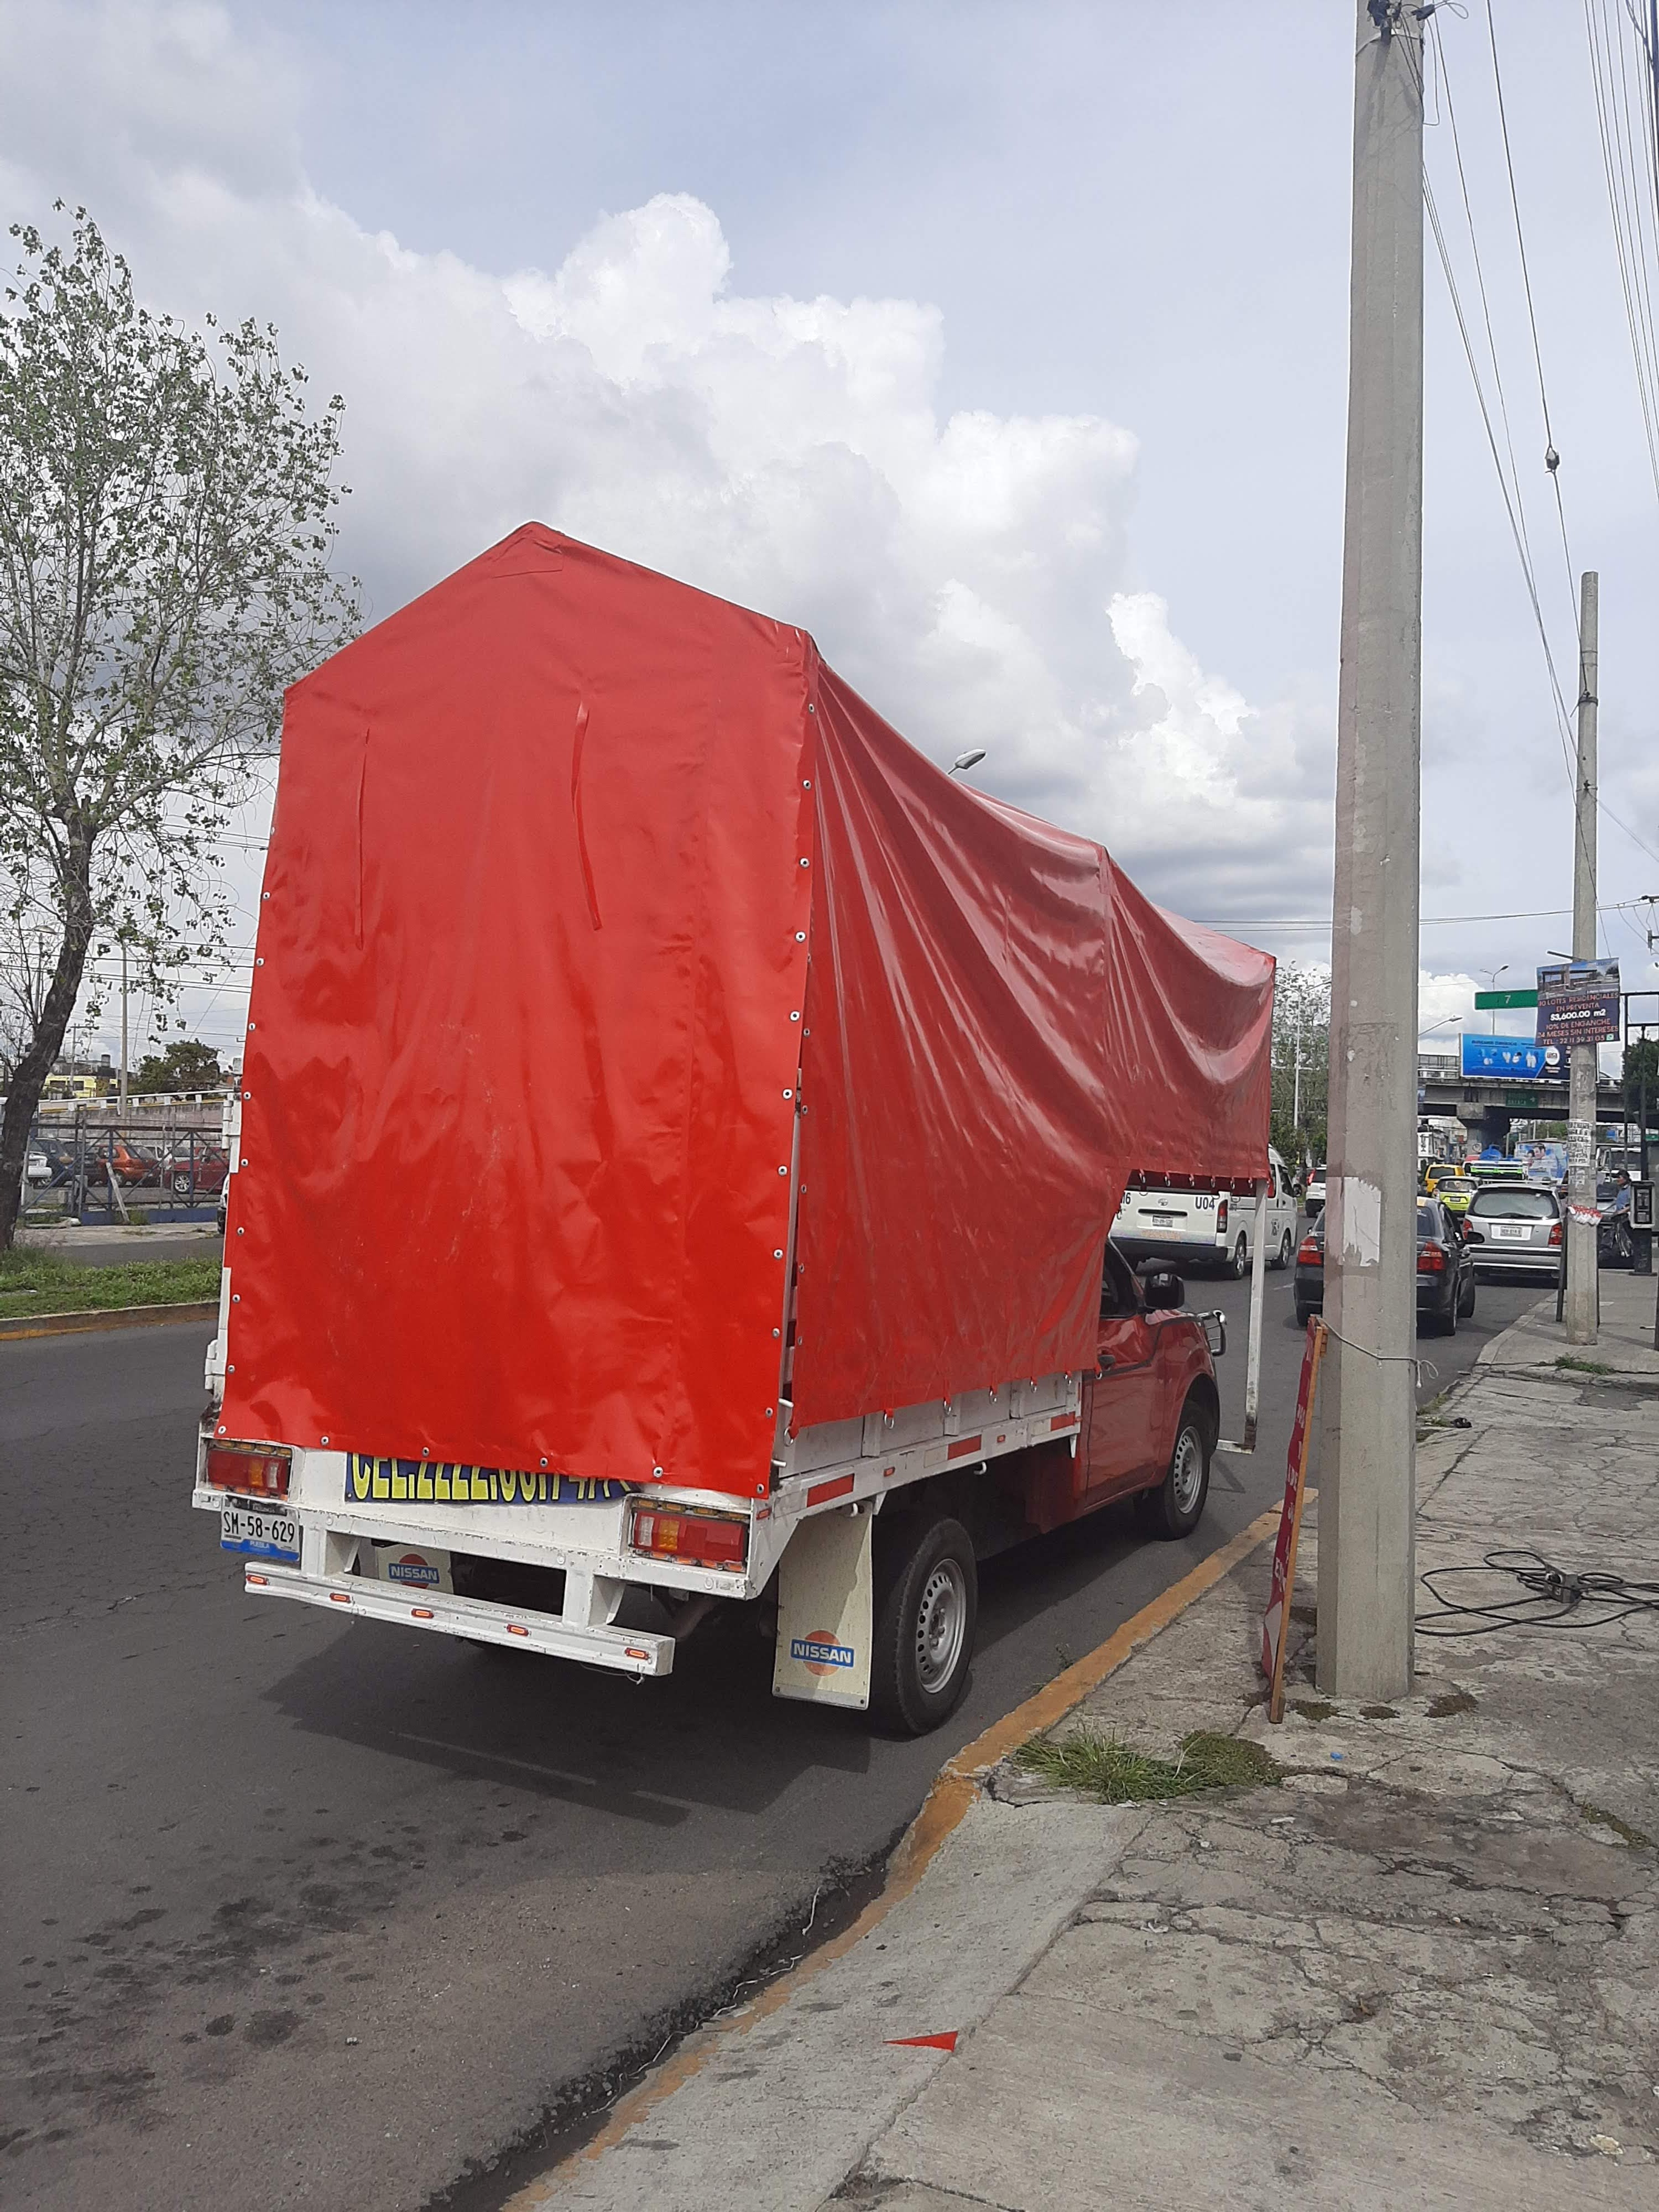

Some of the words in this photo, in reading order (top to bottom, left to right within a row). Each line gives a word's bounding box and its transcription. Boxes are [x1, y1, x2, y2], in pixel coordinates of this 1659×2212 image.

[1504, 995, 1511, 1004] 7
[1569, 993, 1619, 1003] RESIDENCIALES
[1566, 1003, 1600, 1011] PREVENTA
[1594, 1008, 1606, 1016] m2
[1571, 1018, 1611, 1028] ENGANCHE
[1583, 1025, 1619, 1034] INTERESES
[1196, 1197, 1215, 1210] U04
[223, 1511, 295, 1543] SM-58-629
[390, 1566, 437, 1580] NISSAN
[793, 1642, 851, 1664] NISSAN
